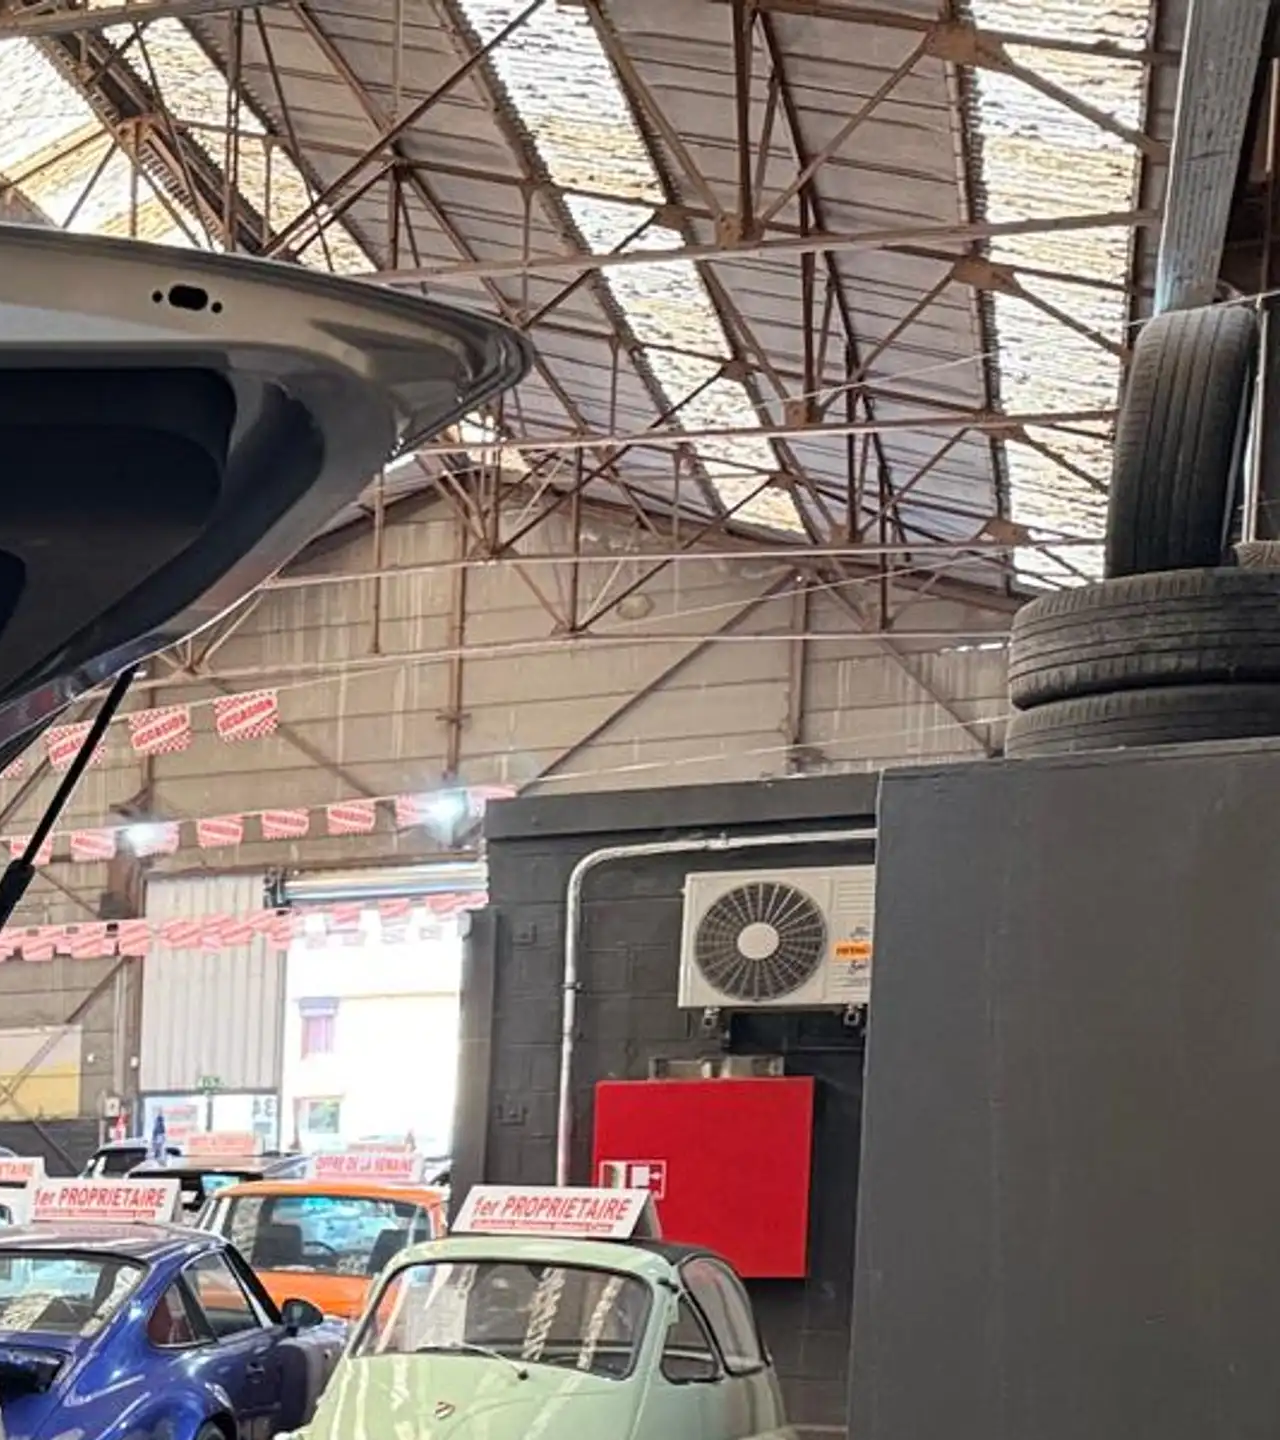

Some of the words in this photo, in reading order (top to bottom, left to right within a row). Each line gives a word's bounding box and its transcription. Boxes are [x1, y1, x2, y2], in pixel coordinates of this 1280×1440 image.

[34, 1189, 55, 1206] 1er
[58, 1187, 167, 1208] PROPRIETAIRE
[474, 1195, 498, 1216] 1er
[501, 1196, 632, 1220] PROPRIETAIRE
